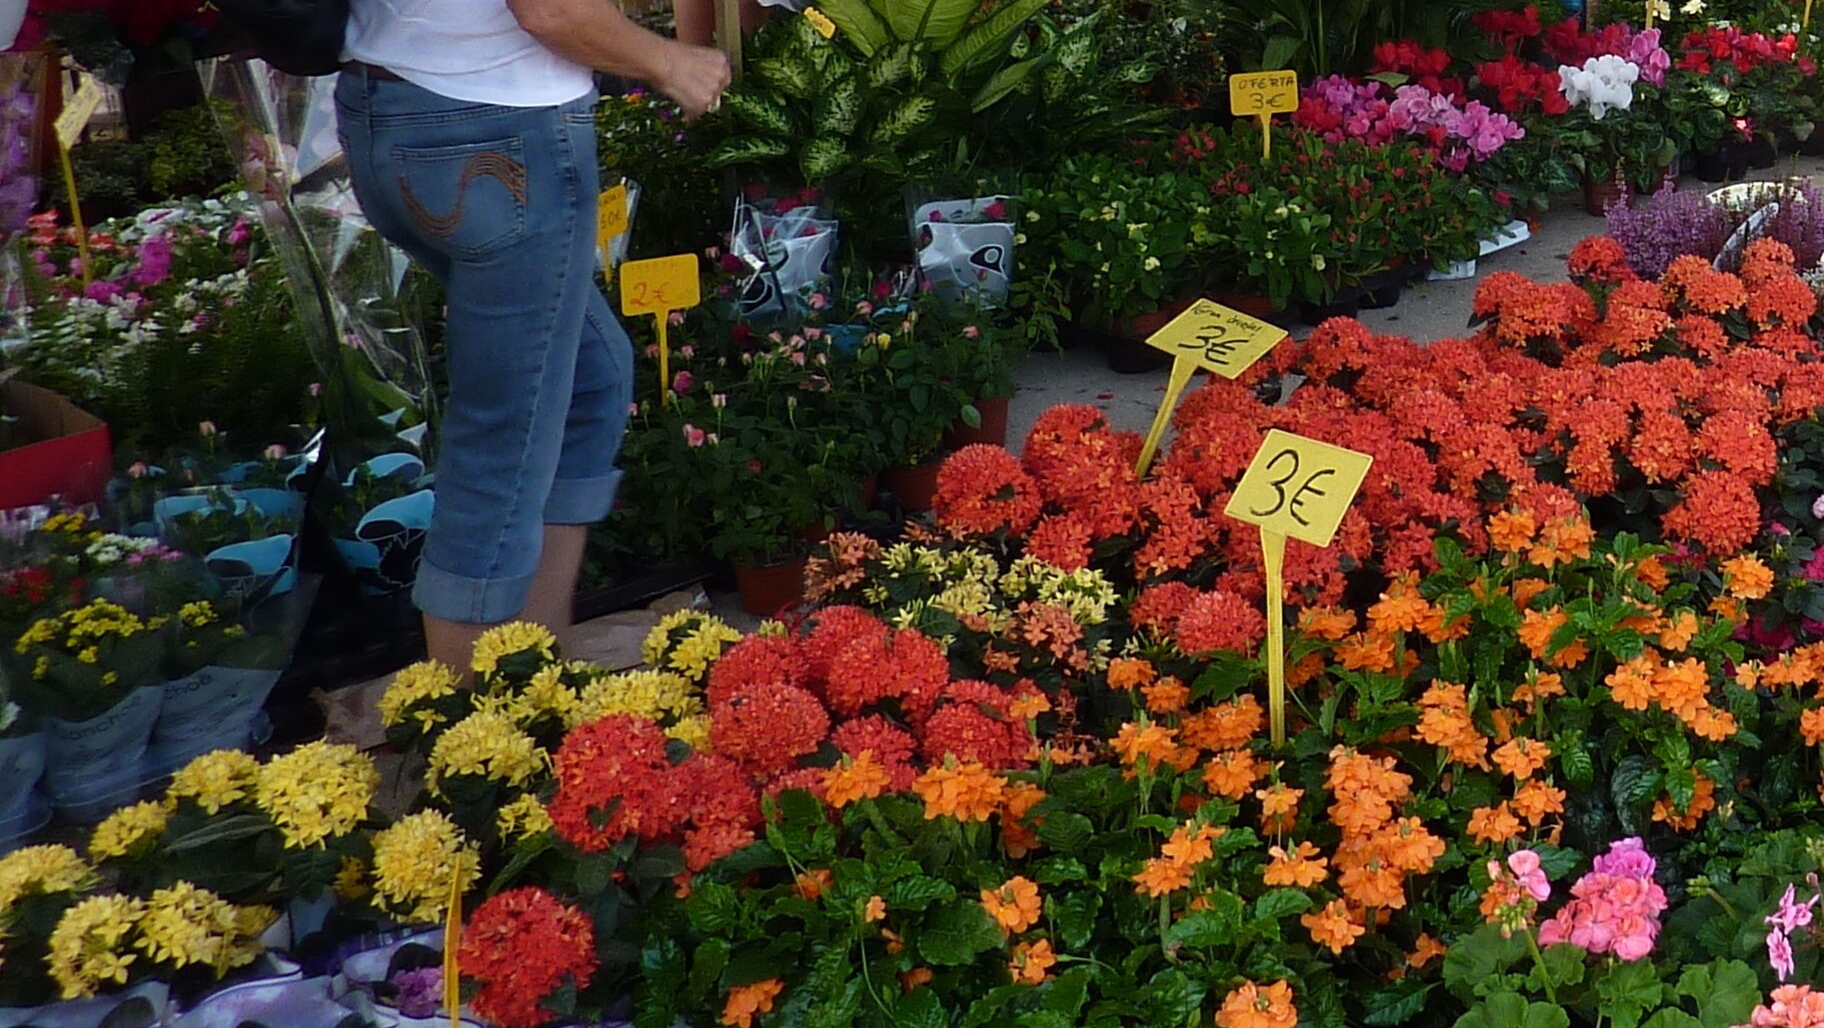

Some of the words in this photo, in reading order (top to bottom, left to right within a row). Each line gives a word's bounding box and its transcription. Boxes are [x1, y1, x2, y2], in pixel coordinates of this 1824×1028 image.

[1238, 76, 1294, 90] OFERTA
[1177, 325, 1249, 365] 3€
[1250, 449, 1336, 526] 3€
